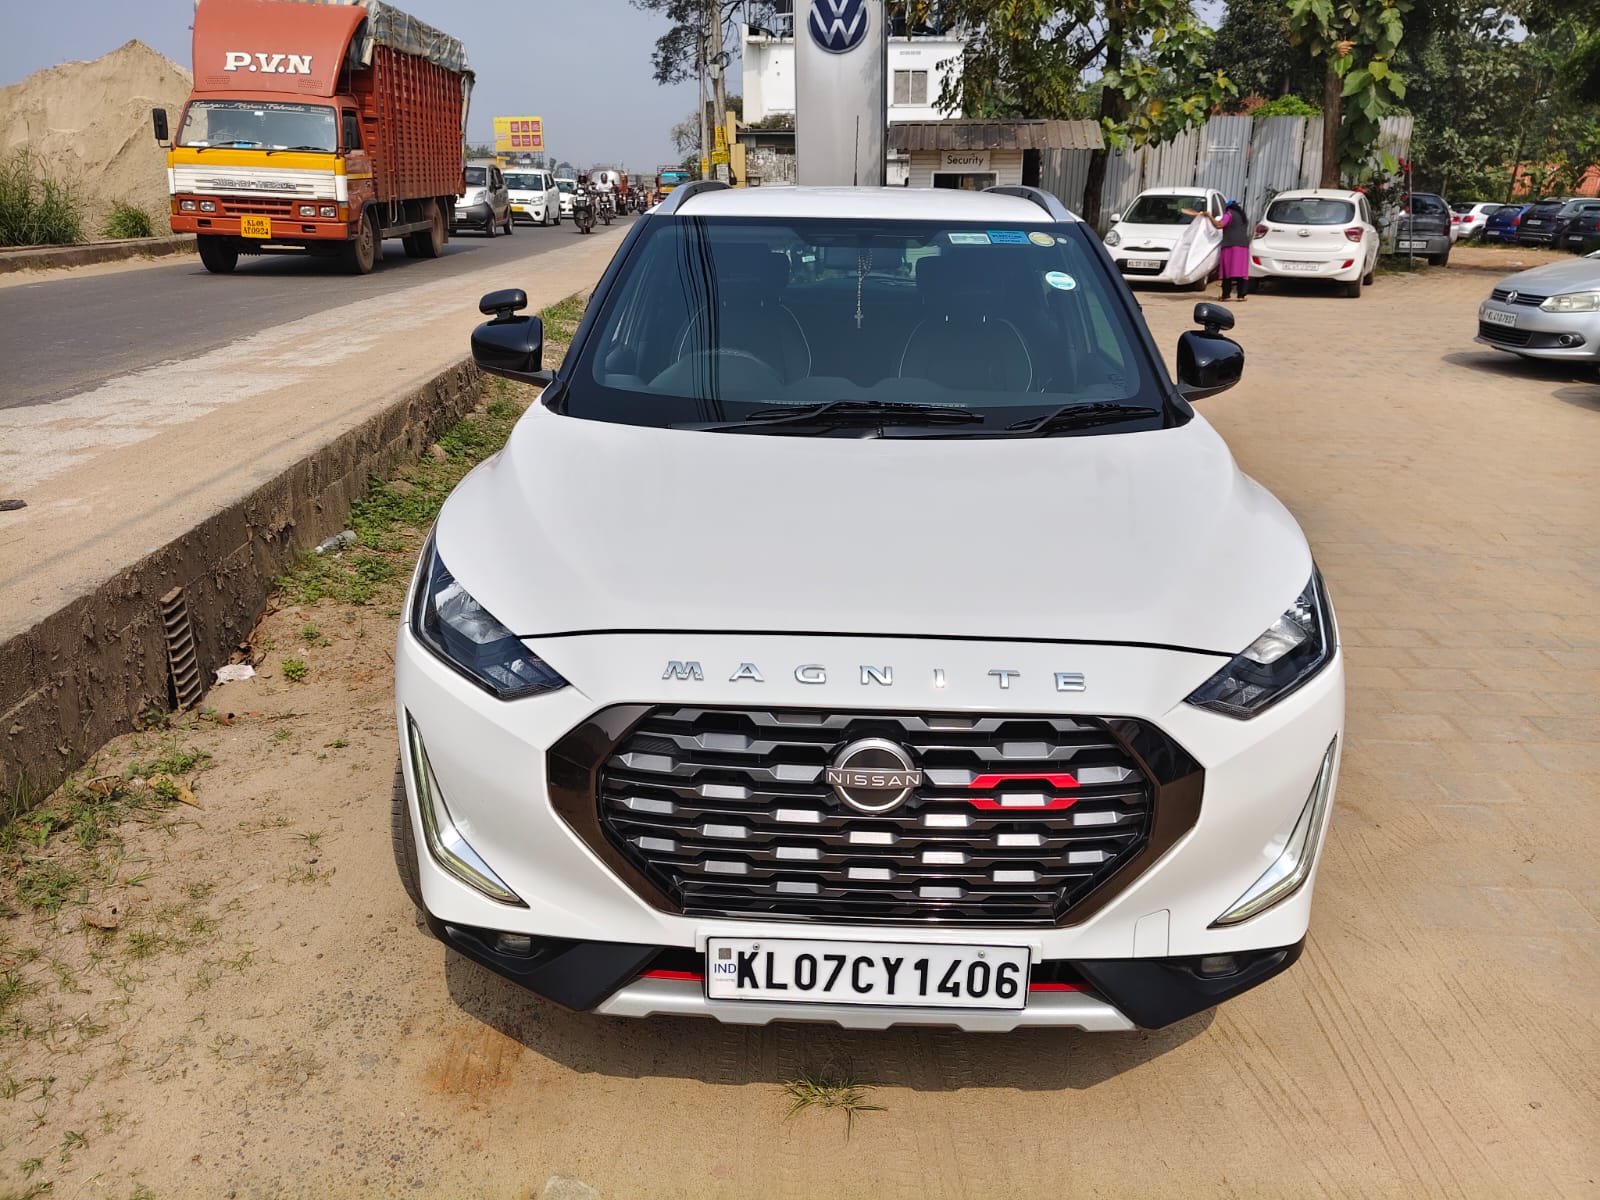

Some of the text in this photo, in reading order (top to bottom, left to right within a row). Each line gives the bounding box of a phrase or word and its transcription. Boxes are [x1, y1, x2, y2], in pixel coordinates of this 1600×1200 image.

[223, 51, 313, 75] P.V.N
[946, 154, 984, 167] Security
[662, 660, 1088, 692] MAGNITE
[828, 771, 920, 787] NISSAN
[714, 963, 737, 974] IND
[736, 951, 1020, 999] KL07CY1406
